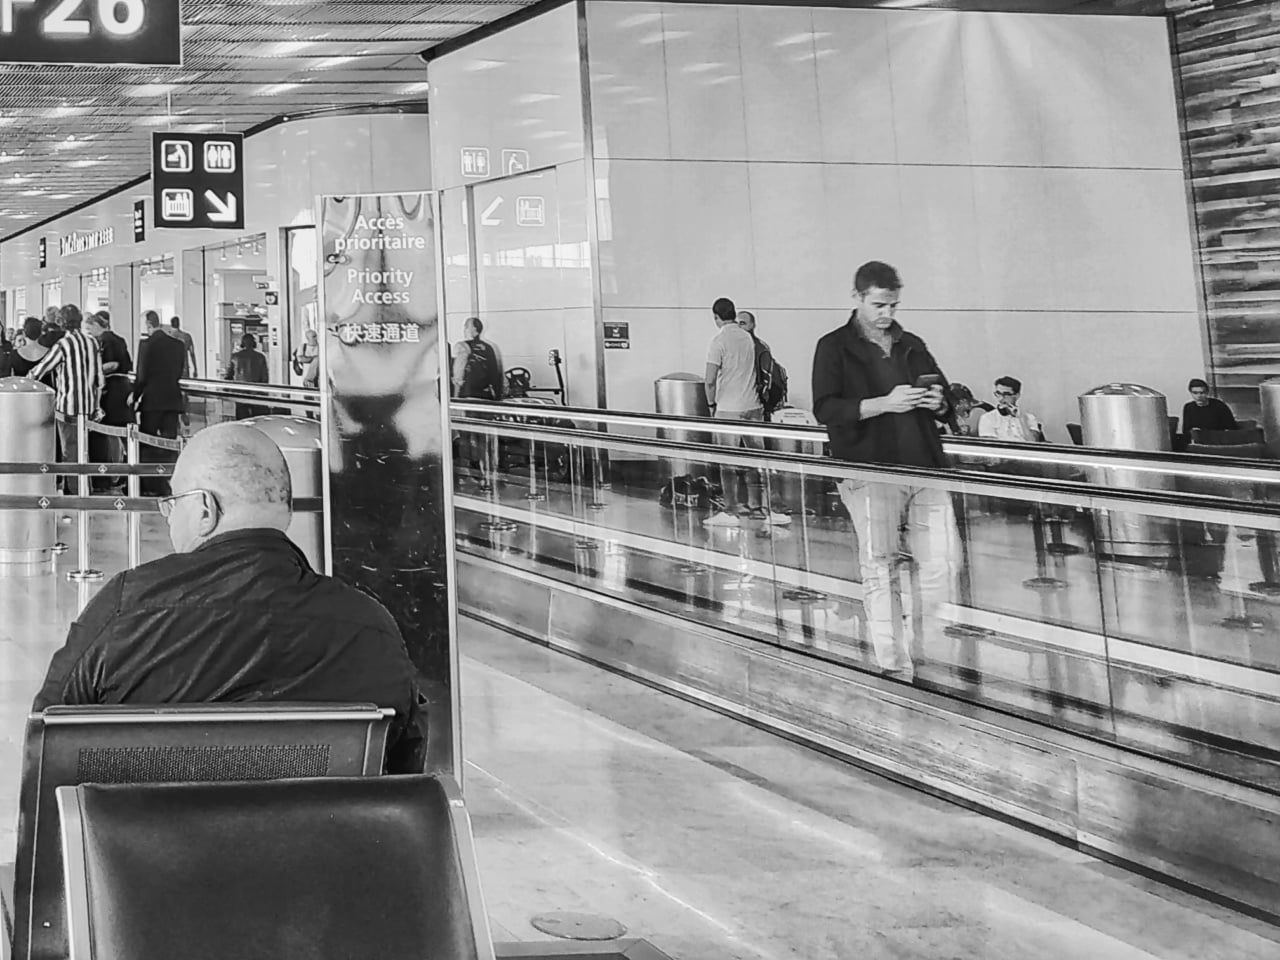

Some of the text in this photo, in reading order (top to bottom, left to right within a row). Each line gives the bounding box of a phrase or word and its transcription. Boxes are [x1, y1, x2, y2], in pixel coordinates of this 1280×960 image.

[355, 214, 405, 230] Accès
[335, 234, 425, 253] prioritaire
[347, 268, 413, 287] Priority
[352, 289, 410, 304] Access
[342, 323, 420, 343] 快速通道
